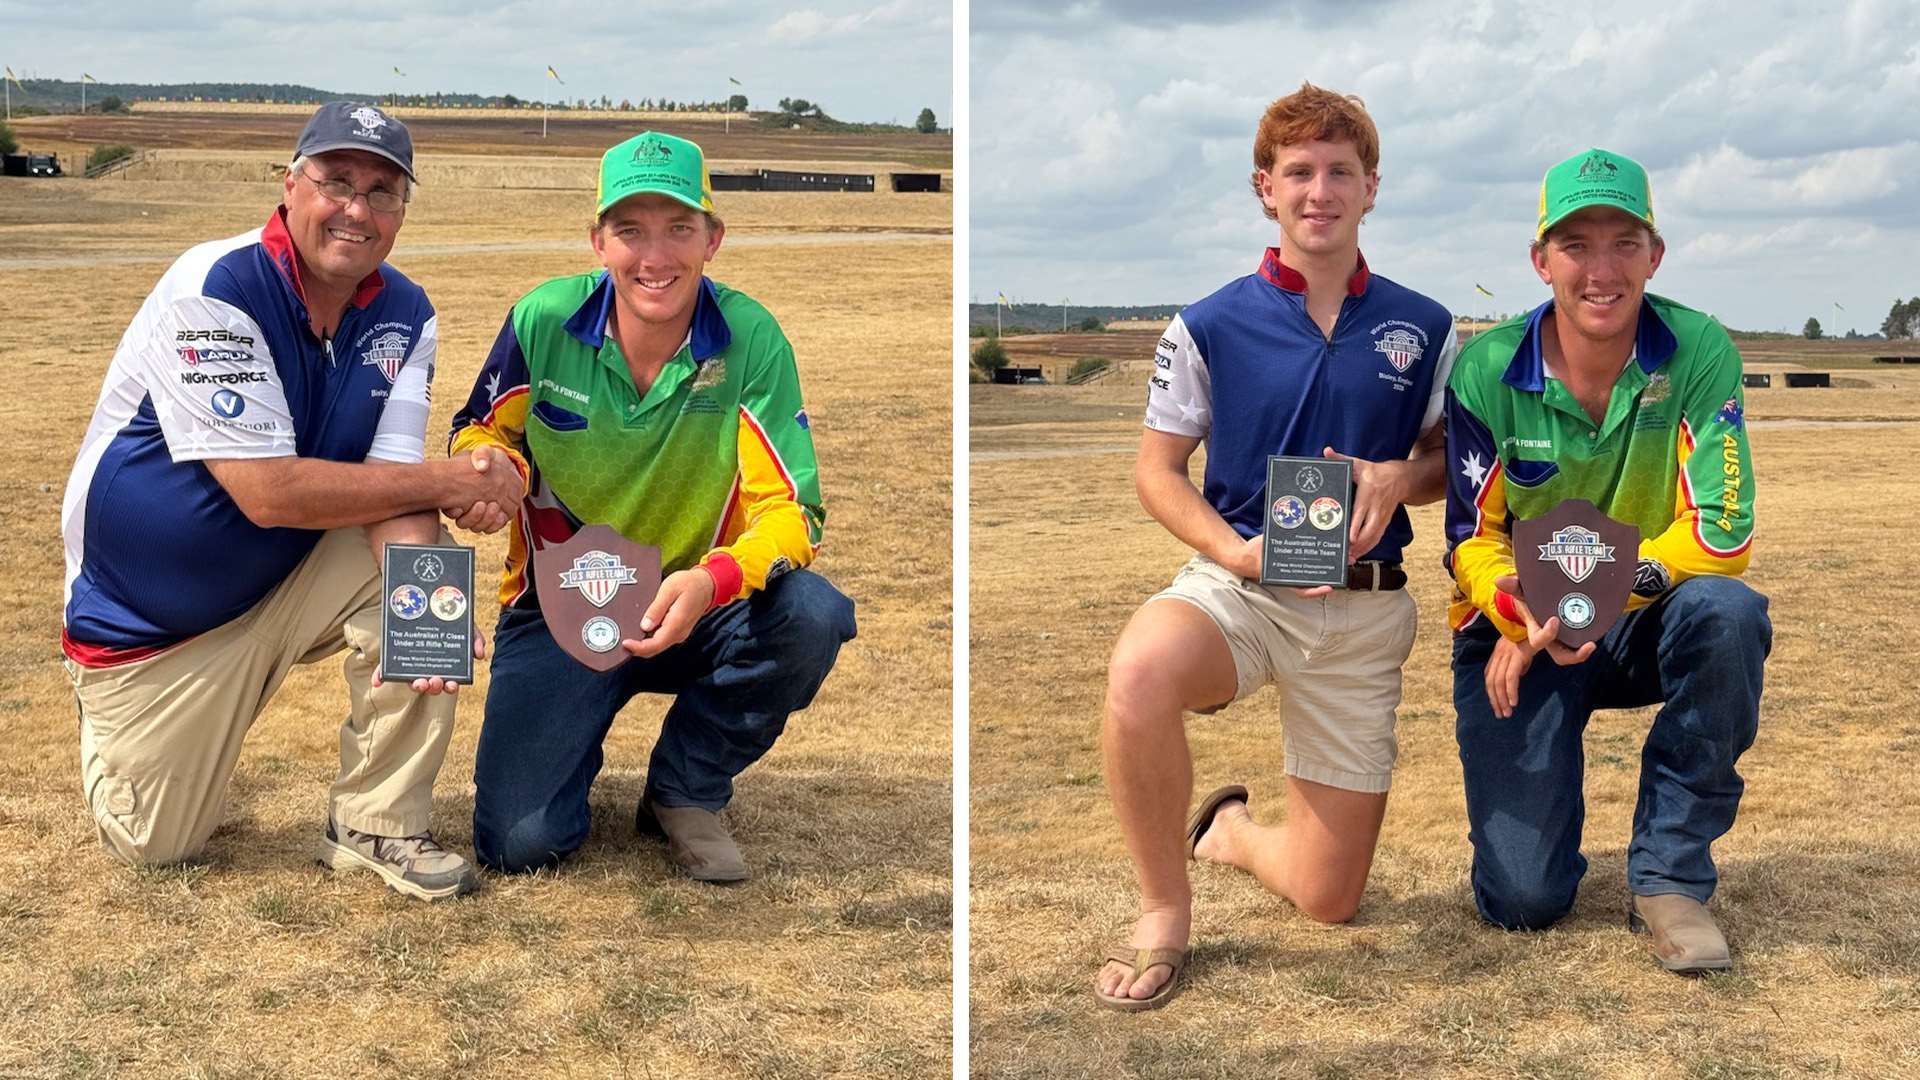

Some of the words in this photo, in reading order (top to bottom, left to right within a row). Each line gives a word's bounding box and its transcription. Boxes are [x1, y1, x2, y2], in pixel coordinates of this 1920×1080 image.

[176, 330, 254, 348] BERGER
[356, 328, 374, 348] World
[180, 372, 268, 384] NIGHTFORCE
[560, 385, 590, 404] FONTAINE
[1520, 439, 1552, 448] FONTAINE
[1716, 433, 1740, 532] AUSTRALA
[1565, 545, 1584, 554] RIFLE
